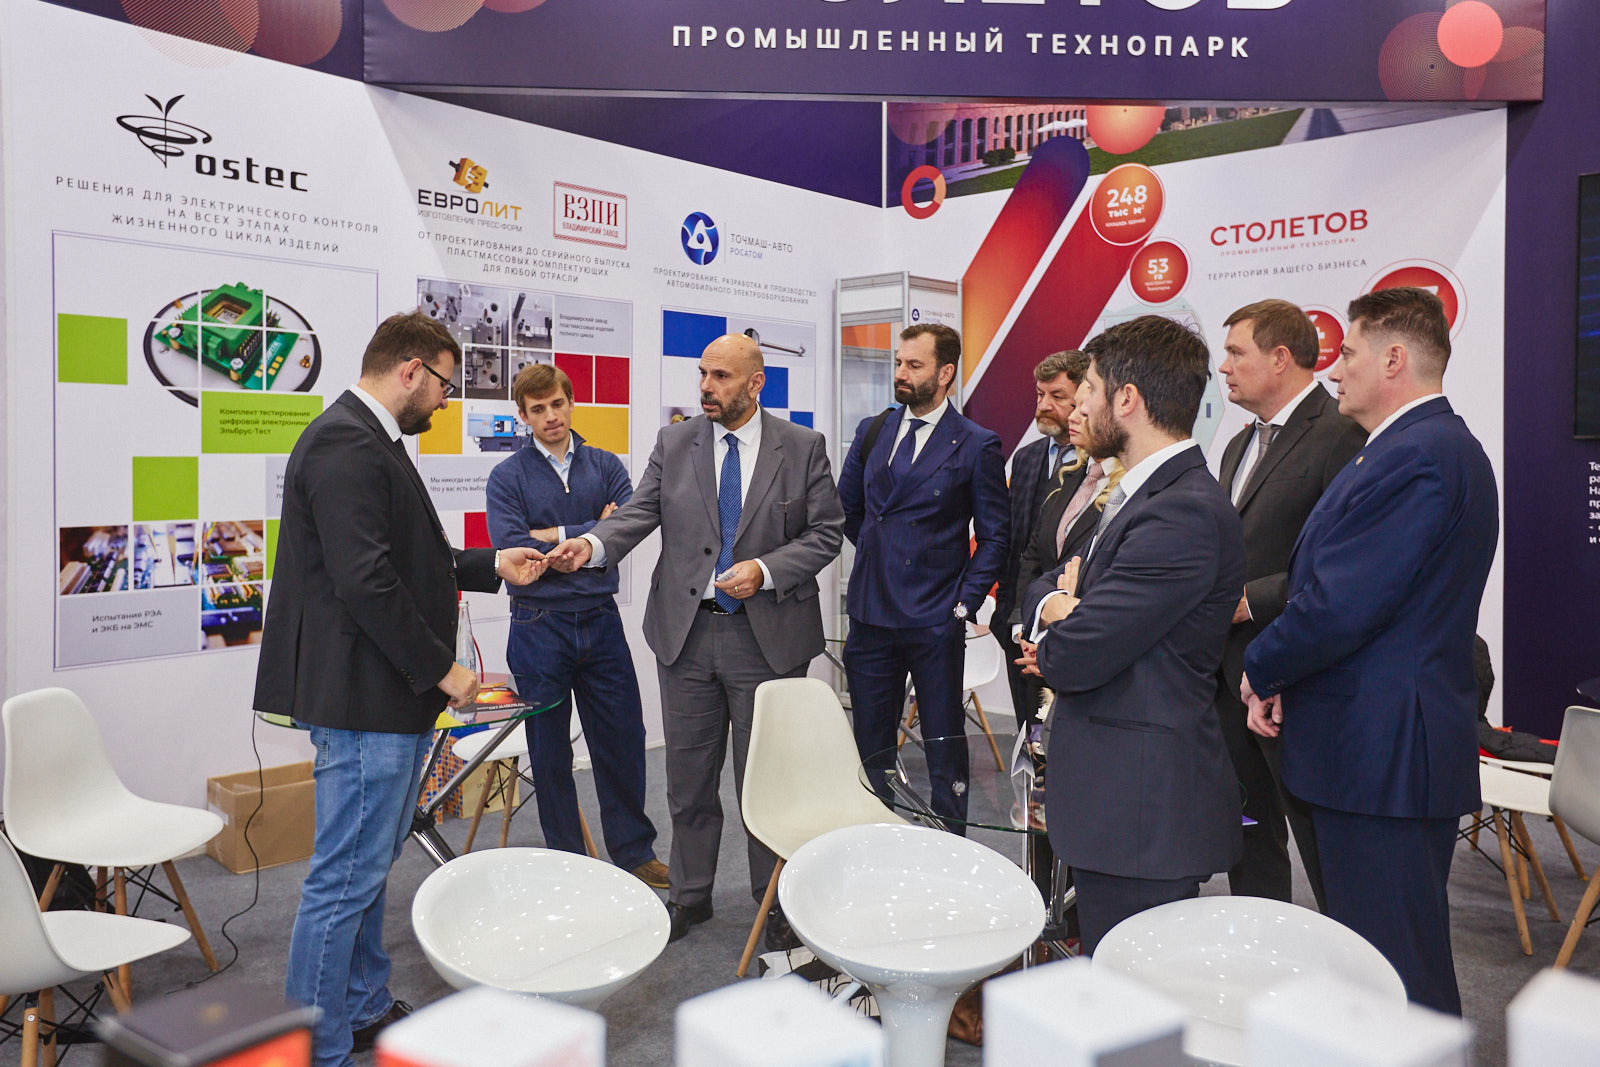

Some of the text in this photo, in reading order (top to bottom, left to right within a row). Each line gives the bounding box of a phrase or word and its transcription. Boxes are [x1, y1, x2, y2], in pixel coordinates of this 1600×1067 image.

[671, 25, 1250, 58] ПРОМЫШЛЕННЫЙ ТЕХНОПАРК
[194, 153, 308, 192] ostec
[55, 176, 379, 234] РЕШЕНИЯ ДЛЯ ЭЛЕКТРИЧЕСКОГО КОНТРОЛЯ
[418, 189, 522, 221] ЕВРОЛИТ
[1106, 185, 1148, 209] 248
[167, 207, 290, 234] НА ВСЕХ ЭТАПАХ
[417, 209, 475, 226] ИЗГОТОВЛЕНИЕ
[563, 194, 619, 226] ВЗПИ
[111, 213, 340, 253] ЖИЗНЕННОГО ЦИКЛА ИЗДЕЛИЙ
[1210, 209, 1368, 246] СТОЛЕТОВ
[418, 230, 631, 269] ОТ ПРОЕКТИРОВАНИЯ ДО СЕРИЙНОГО ВЫПУСКА
[730, 233, 793, 253] ТОЧМАШ-АВТО
[730, 247, 763, 260] РОСАТОМ
[1220, 237, 1356, 257] ПРОМЫШЛЕННЫЙ ТЕХНОПАРК
[447, 246, 609, 277] ПЛАСТМАССОВЫХ КОМПЛЕКТУЮЩИХ
[1147, 257, 1169, 275] 53
[1207, 258, 1367, 281] ТЕРРИТОРИЯ ВАШЕГО БИЗНЕСА
[482, 263, 579, 284] ДЛЯ ЛЮБОЙ ОТРАСЛИ
[666, 279, 731, 295] АВТОМОБИЛЬНОГО
[722, 277, 762, 290] РАЗРАБОТКА
[770, 284, 817, 298] ПРОИЗВОДСТВО
[219, 408, 310, 418] Комплект тестирования
[219, 418, 260, 426] цифровой
[219, 427, 271, 436] Эльбрус-Тест
[92, 609, 162, 622] Испытания РЭА
[100, 624, 119, 633] ЭКБ
[133, 620, 153, 630] ЭМС
